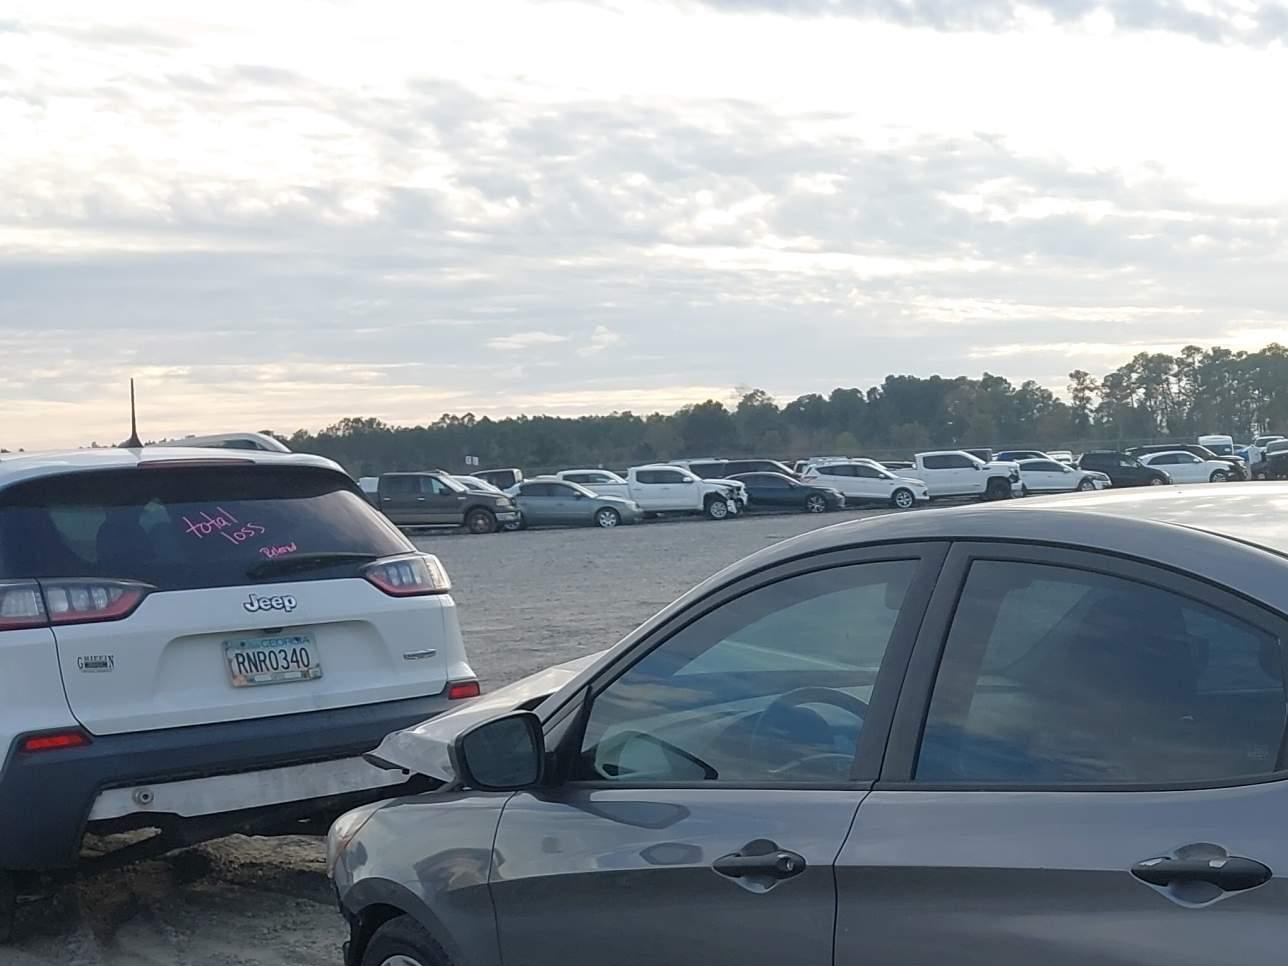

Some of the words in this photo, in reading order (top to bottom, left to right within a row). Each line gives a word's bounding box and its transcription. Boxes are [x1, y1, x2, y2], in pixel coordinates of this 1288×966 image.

[182, 506, 238, 538] total
[221, 522, 265, 545] loss
[243, 593, 298, 612] Jeep
[234, 647, 310, 674] RNR0340
